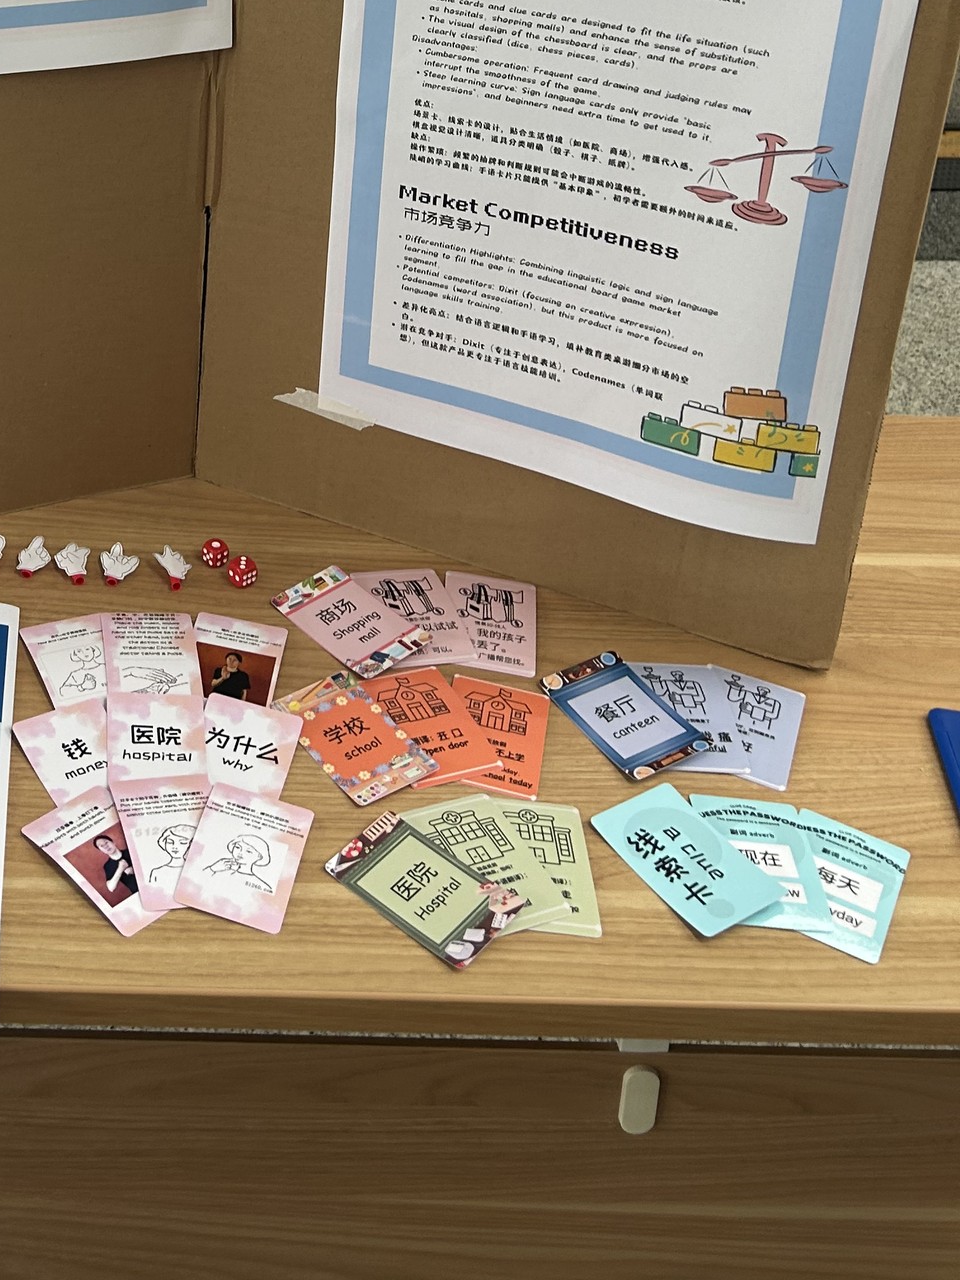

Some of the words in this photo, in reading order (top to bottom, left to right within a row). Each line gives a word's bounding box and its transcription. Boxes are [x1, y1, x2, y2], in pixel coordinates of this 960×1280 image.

[411, 34, 478, 52] Disadvantages:
[398, 184, 479, 215] Market
[484, 202, 679, 260] Competitiveness
[404, 207, 491, 237] 市场竞争力
[401, 283, 439, 298] language
[442, 293, 464, 304] skills
[467, 299, 504, 314] training.
[316, 598, 357, 626] 商场
[332, 611, 382, 641] Shopping
[358, 627, 381, 644] mall
[594, 694, 637, 722] 餐厅
[131, 725, 182, 746] 医院
[323, 715, 370, 745] 学校
[612, 714, 660, 740] canteen
[61, 738, 92, 761] 钱
[122, 749, 192, 764] hospital
[205, 727, 279, 766] 为什么
[345, 737, 382, 761] school
[222, 756, 254, 772] why
[749, 830, 775, 839] adverb
[626, 828, 714, 907] 线索卡
[680, 843, 725, 881] clue
[390, 861, 439, 902] 医院
[414, 877, 462, 921] Hospital
